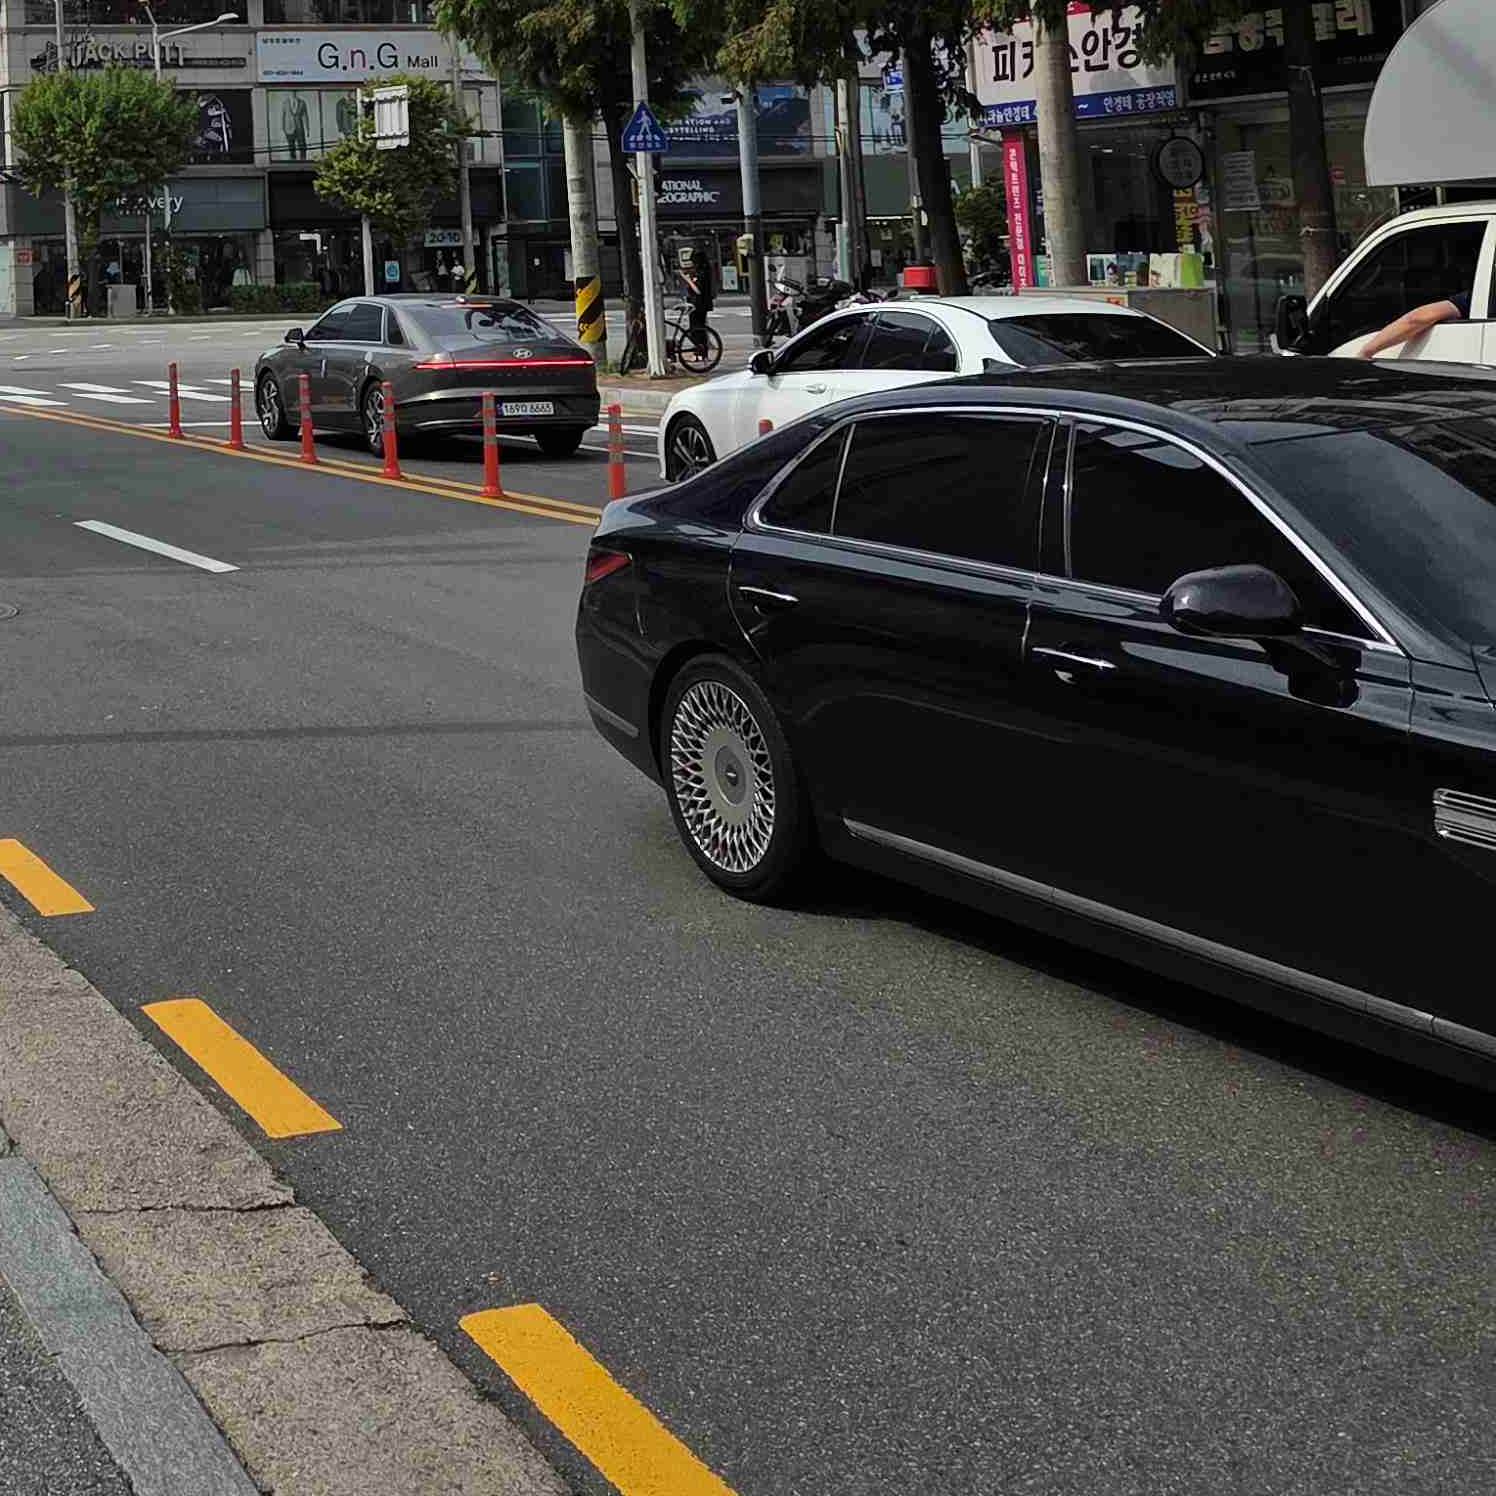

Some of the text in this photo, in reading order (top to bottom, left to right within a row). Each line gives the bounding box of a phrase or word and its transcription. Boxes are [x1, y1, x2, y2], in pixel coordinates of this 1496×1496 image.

[317, 42, 439, 71] G.n.G Mall
[661, 180, 703, 192] ATIONAL
